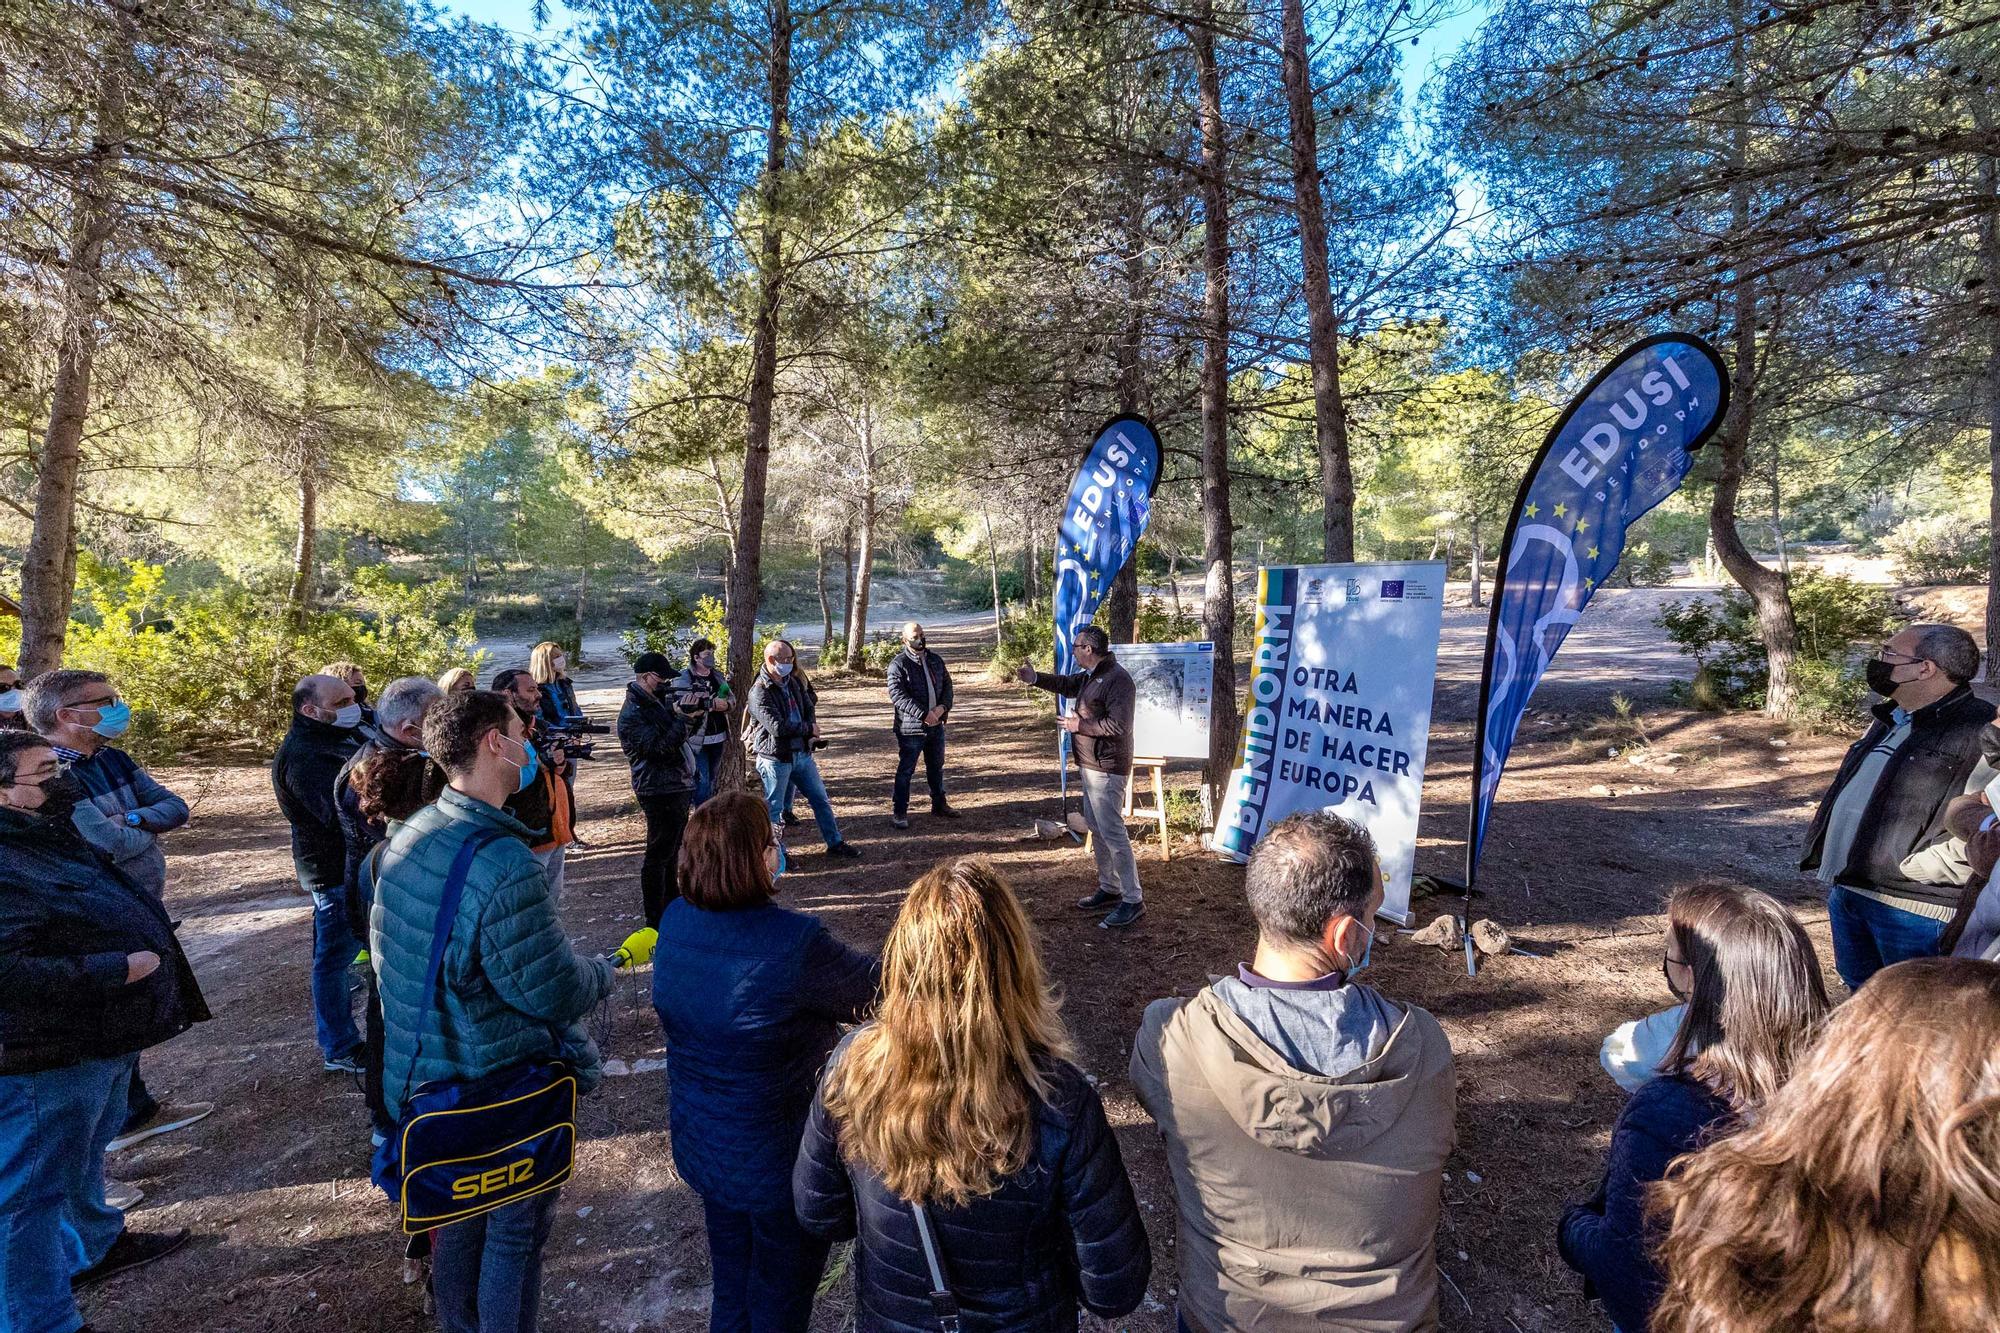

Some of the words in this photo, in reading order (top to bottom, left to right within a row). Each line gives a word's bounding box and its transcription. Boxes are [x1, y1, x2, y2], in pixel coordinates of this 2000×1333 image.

[1559, 356, 1690, 488] EDUSI
[1595, 397, 1698, 502] BENIDORM
[1073, 432, 1137, 532] EDUSI
[1293, 666, 1358, 695] OTRA
[1230, 605, 1292, 834] BENIDORM
[1288, 697, 1394, 737] MANERA
[1284, 728, 1310, 754] DE
[1322, 736, 1410, 777] HACER
[1279, 760, 1377, 806] EUROPA
[452, 1158, 535, 1200] SER
